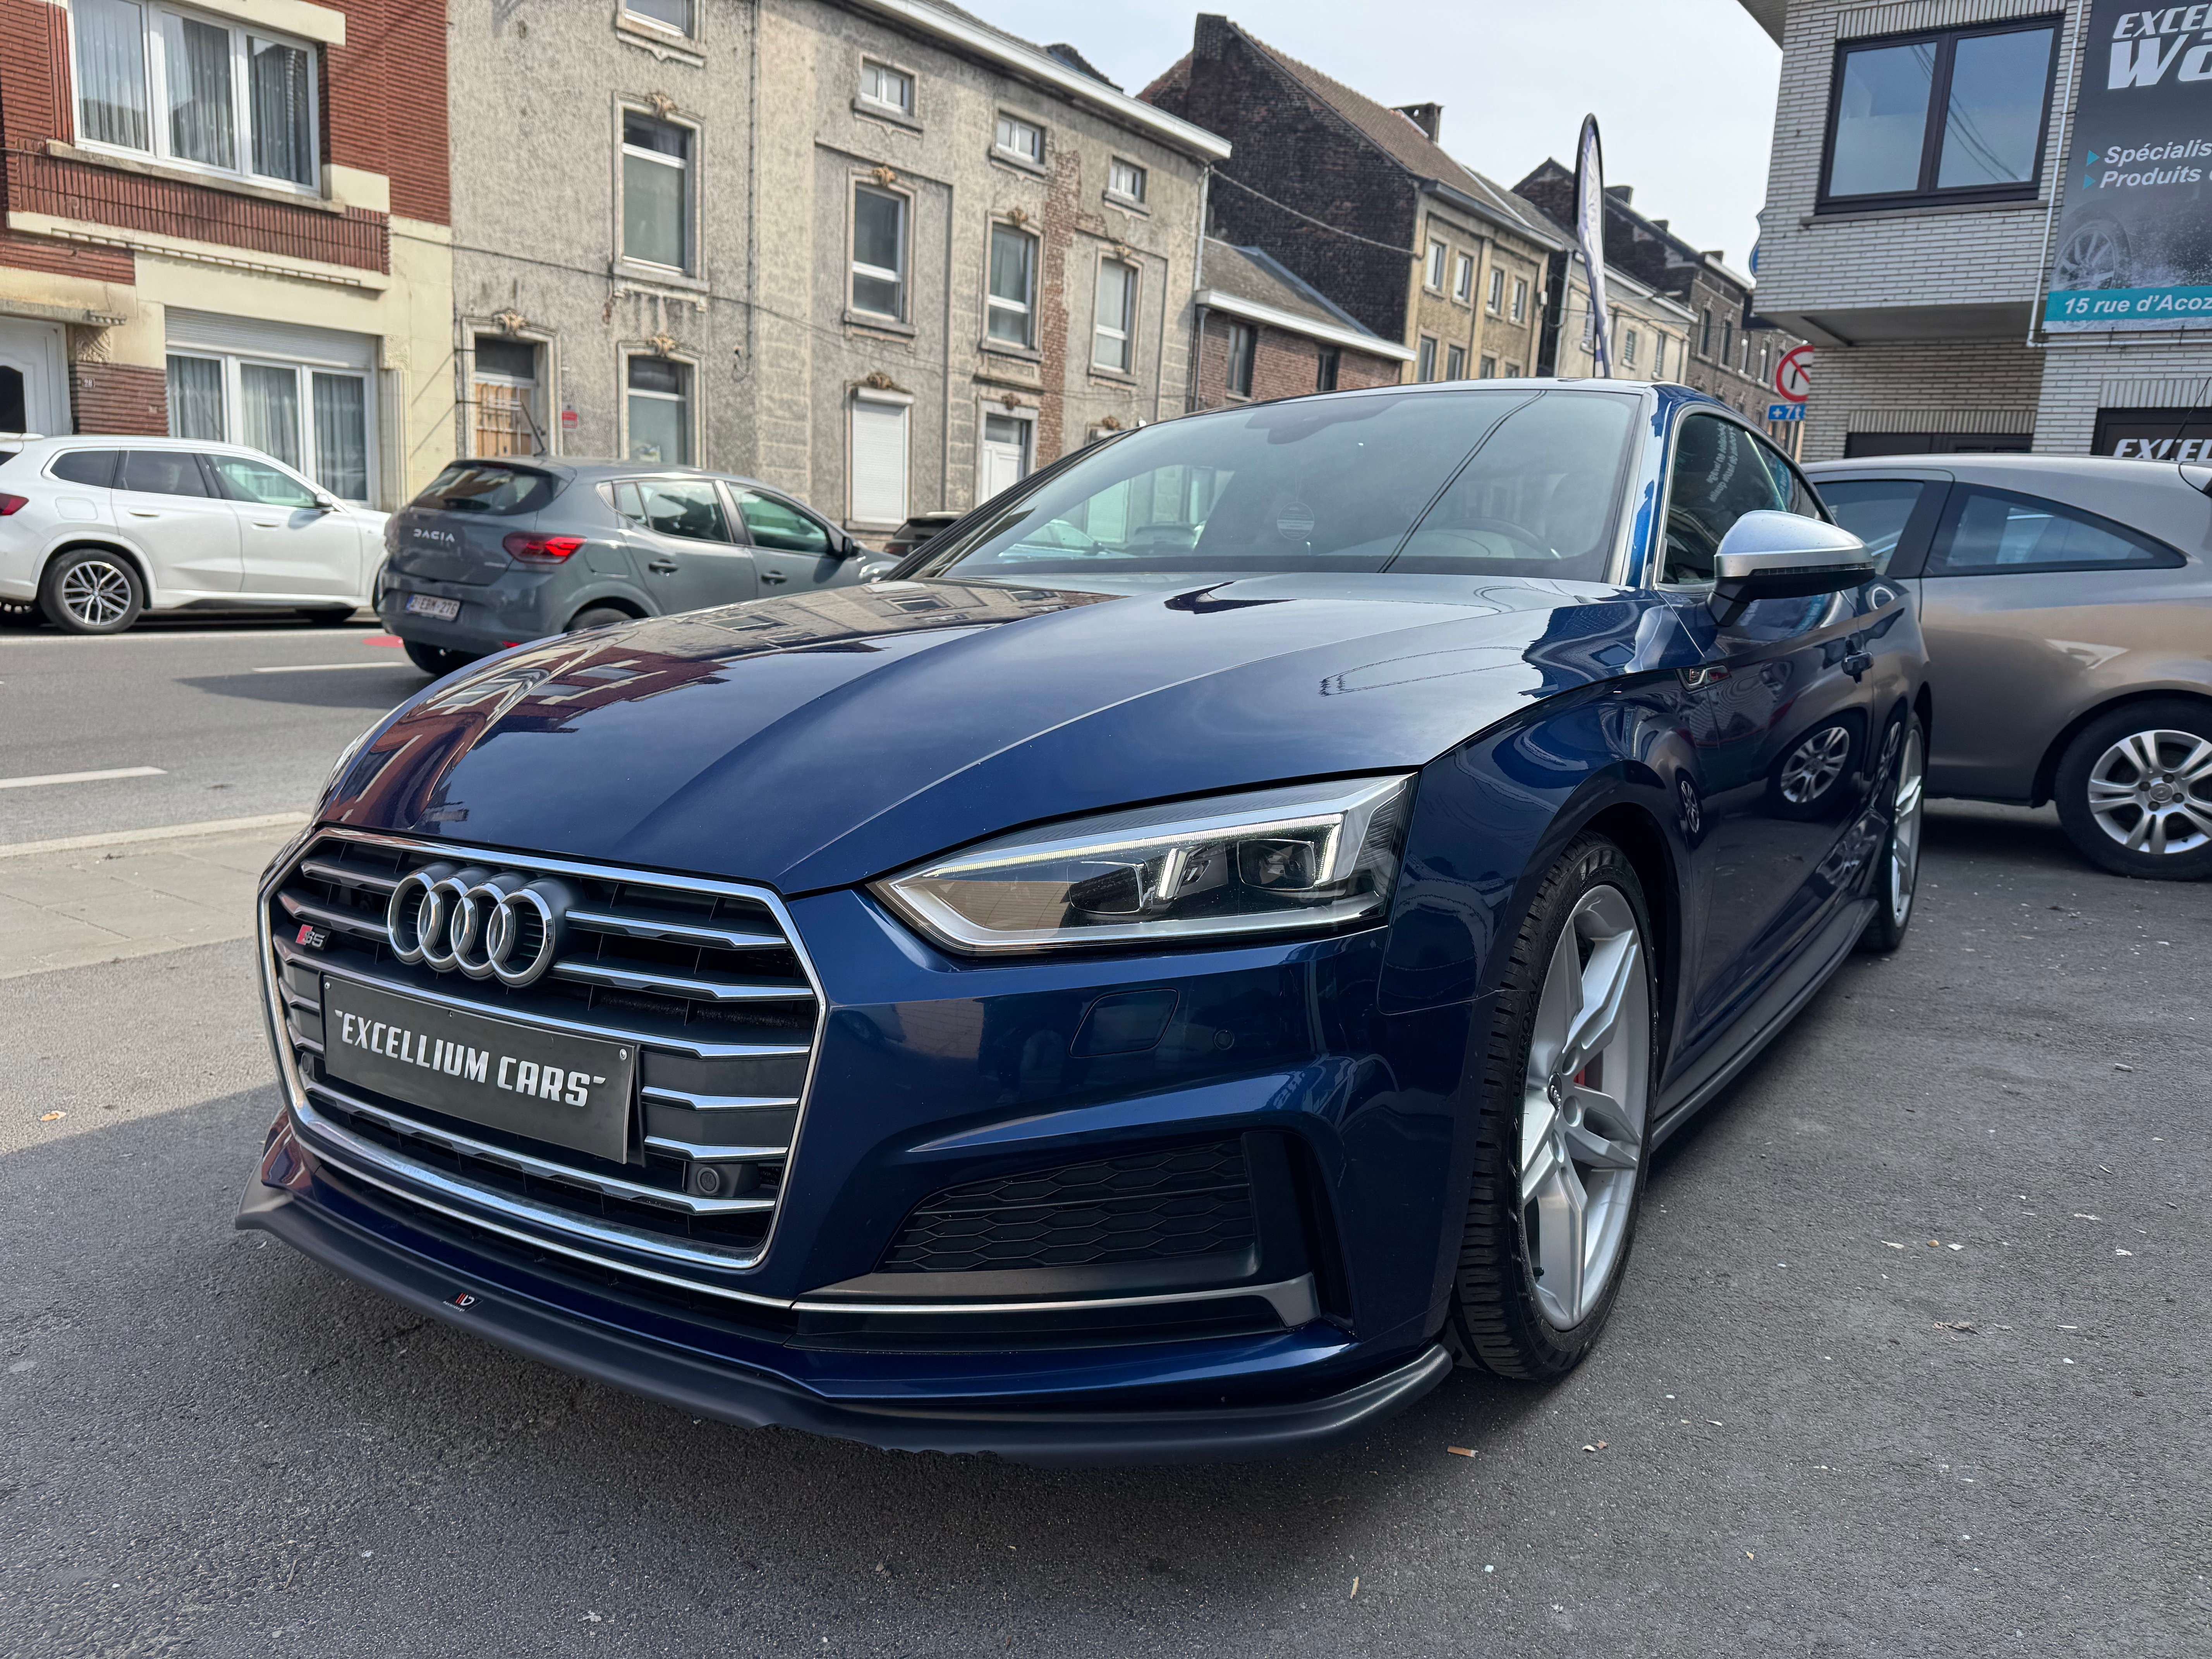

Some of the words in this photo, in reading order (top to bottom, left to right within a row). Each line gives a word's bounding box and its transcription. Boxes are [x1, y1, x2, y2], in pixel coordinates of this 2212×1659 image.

[2099, 166, 2202, 188] Produits
[2065, 297, 2090, 314] 15
[2093, 299, 2130, 313] rue
[413, 528, 455, 542] DACIA
[303, 931, 325, 948] S5
[1513, 977, 1540, 1097] UNIROYAL
[342, 1013, 489, 1084] EXCELLIUM
[497, 1056, 590, 1107] CARS
